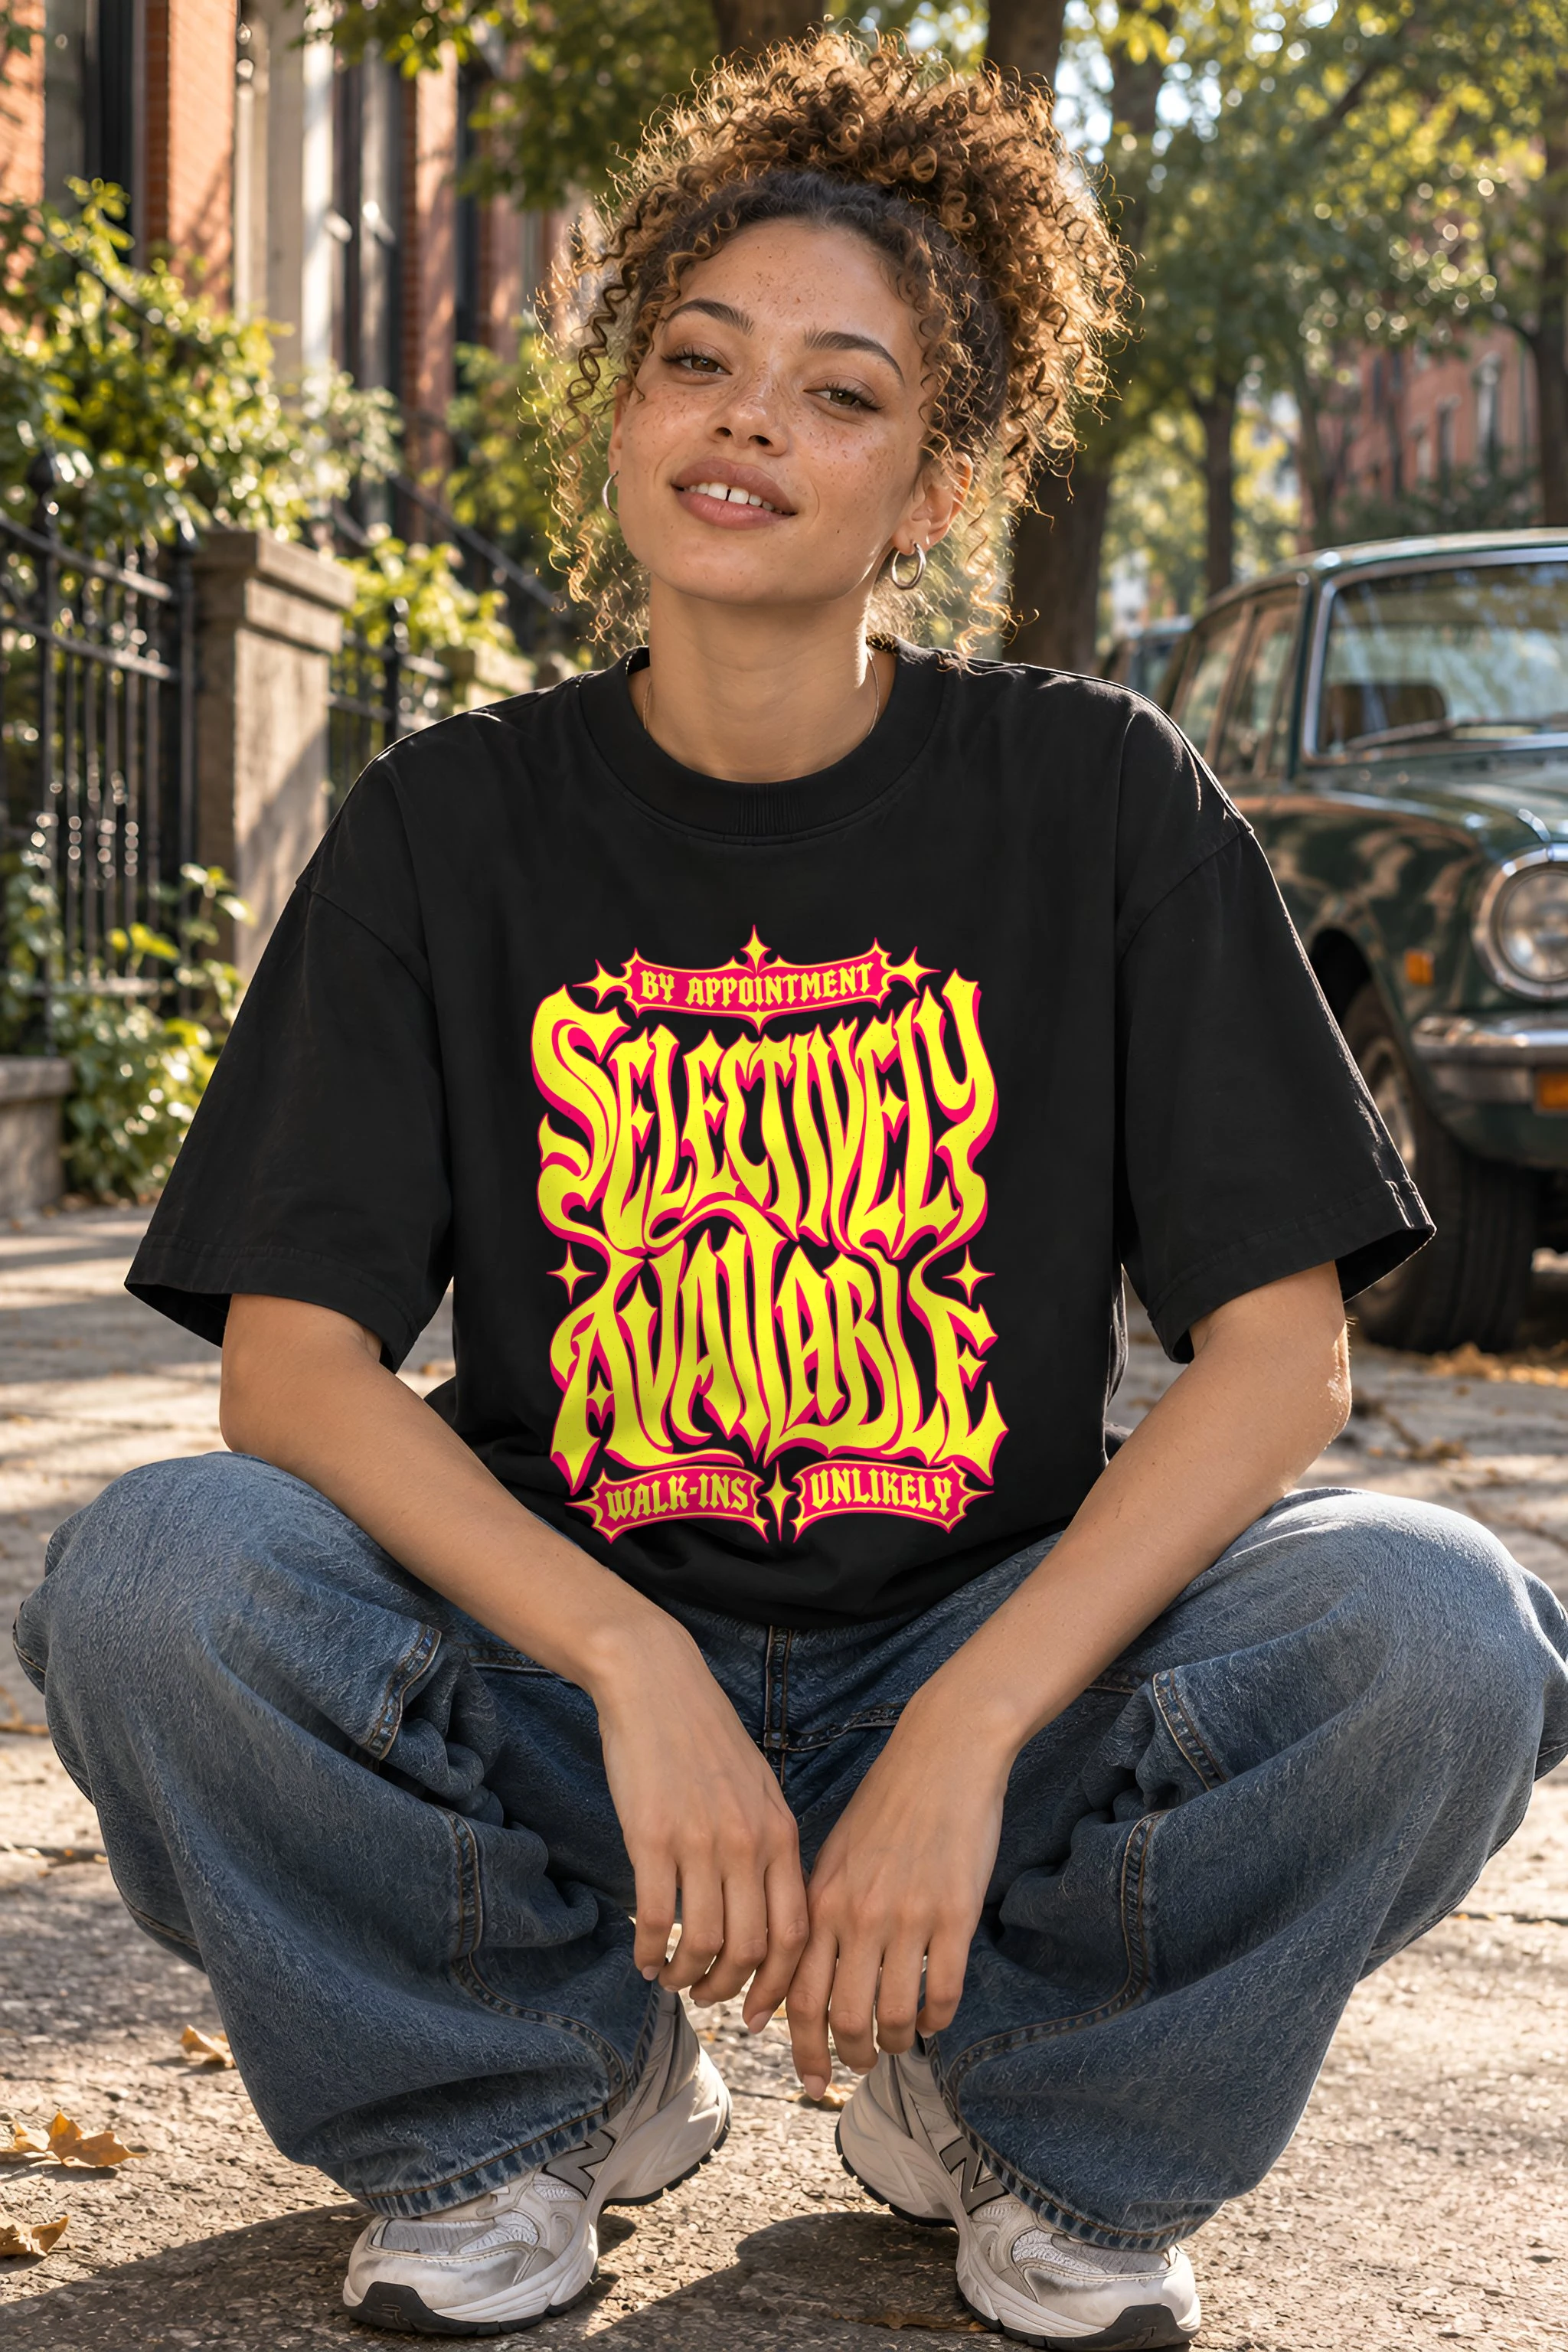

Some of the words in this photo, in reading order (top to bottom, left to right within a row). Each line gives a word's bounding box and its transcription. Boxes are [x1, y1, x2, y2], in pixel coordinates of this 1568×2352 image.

[640, 970, 675, 1003] BY
[684, 961, 874, 1008] APPOINTMENT
[531, 968, 999, 1259] SELECTIVELY
[550, 1223, 1009, 1496] AVAILABLE
[604, 1472, 749, 1521] WALK-INS
[809, 1468, 953, 1517] UNLIKELY
